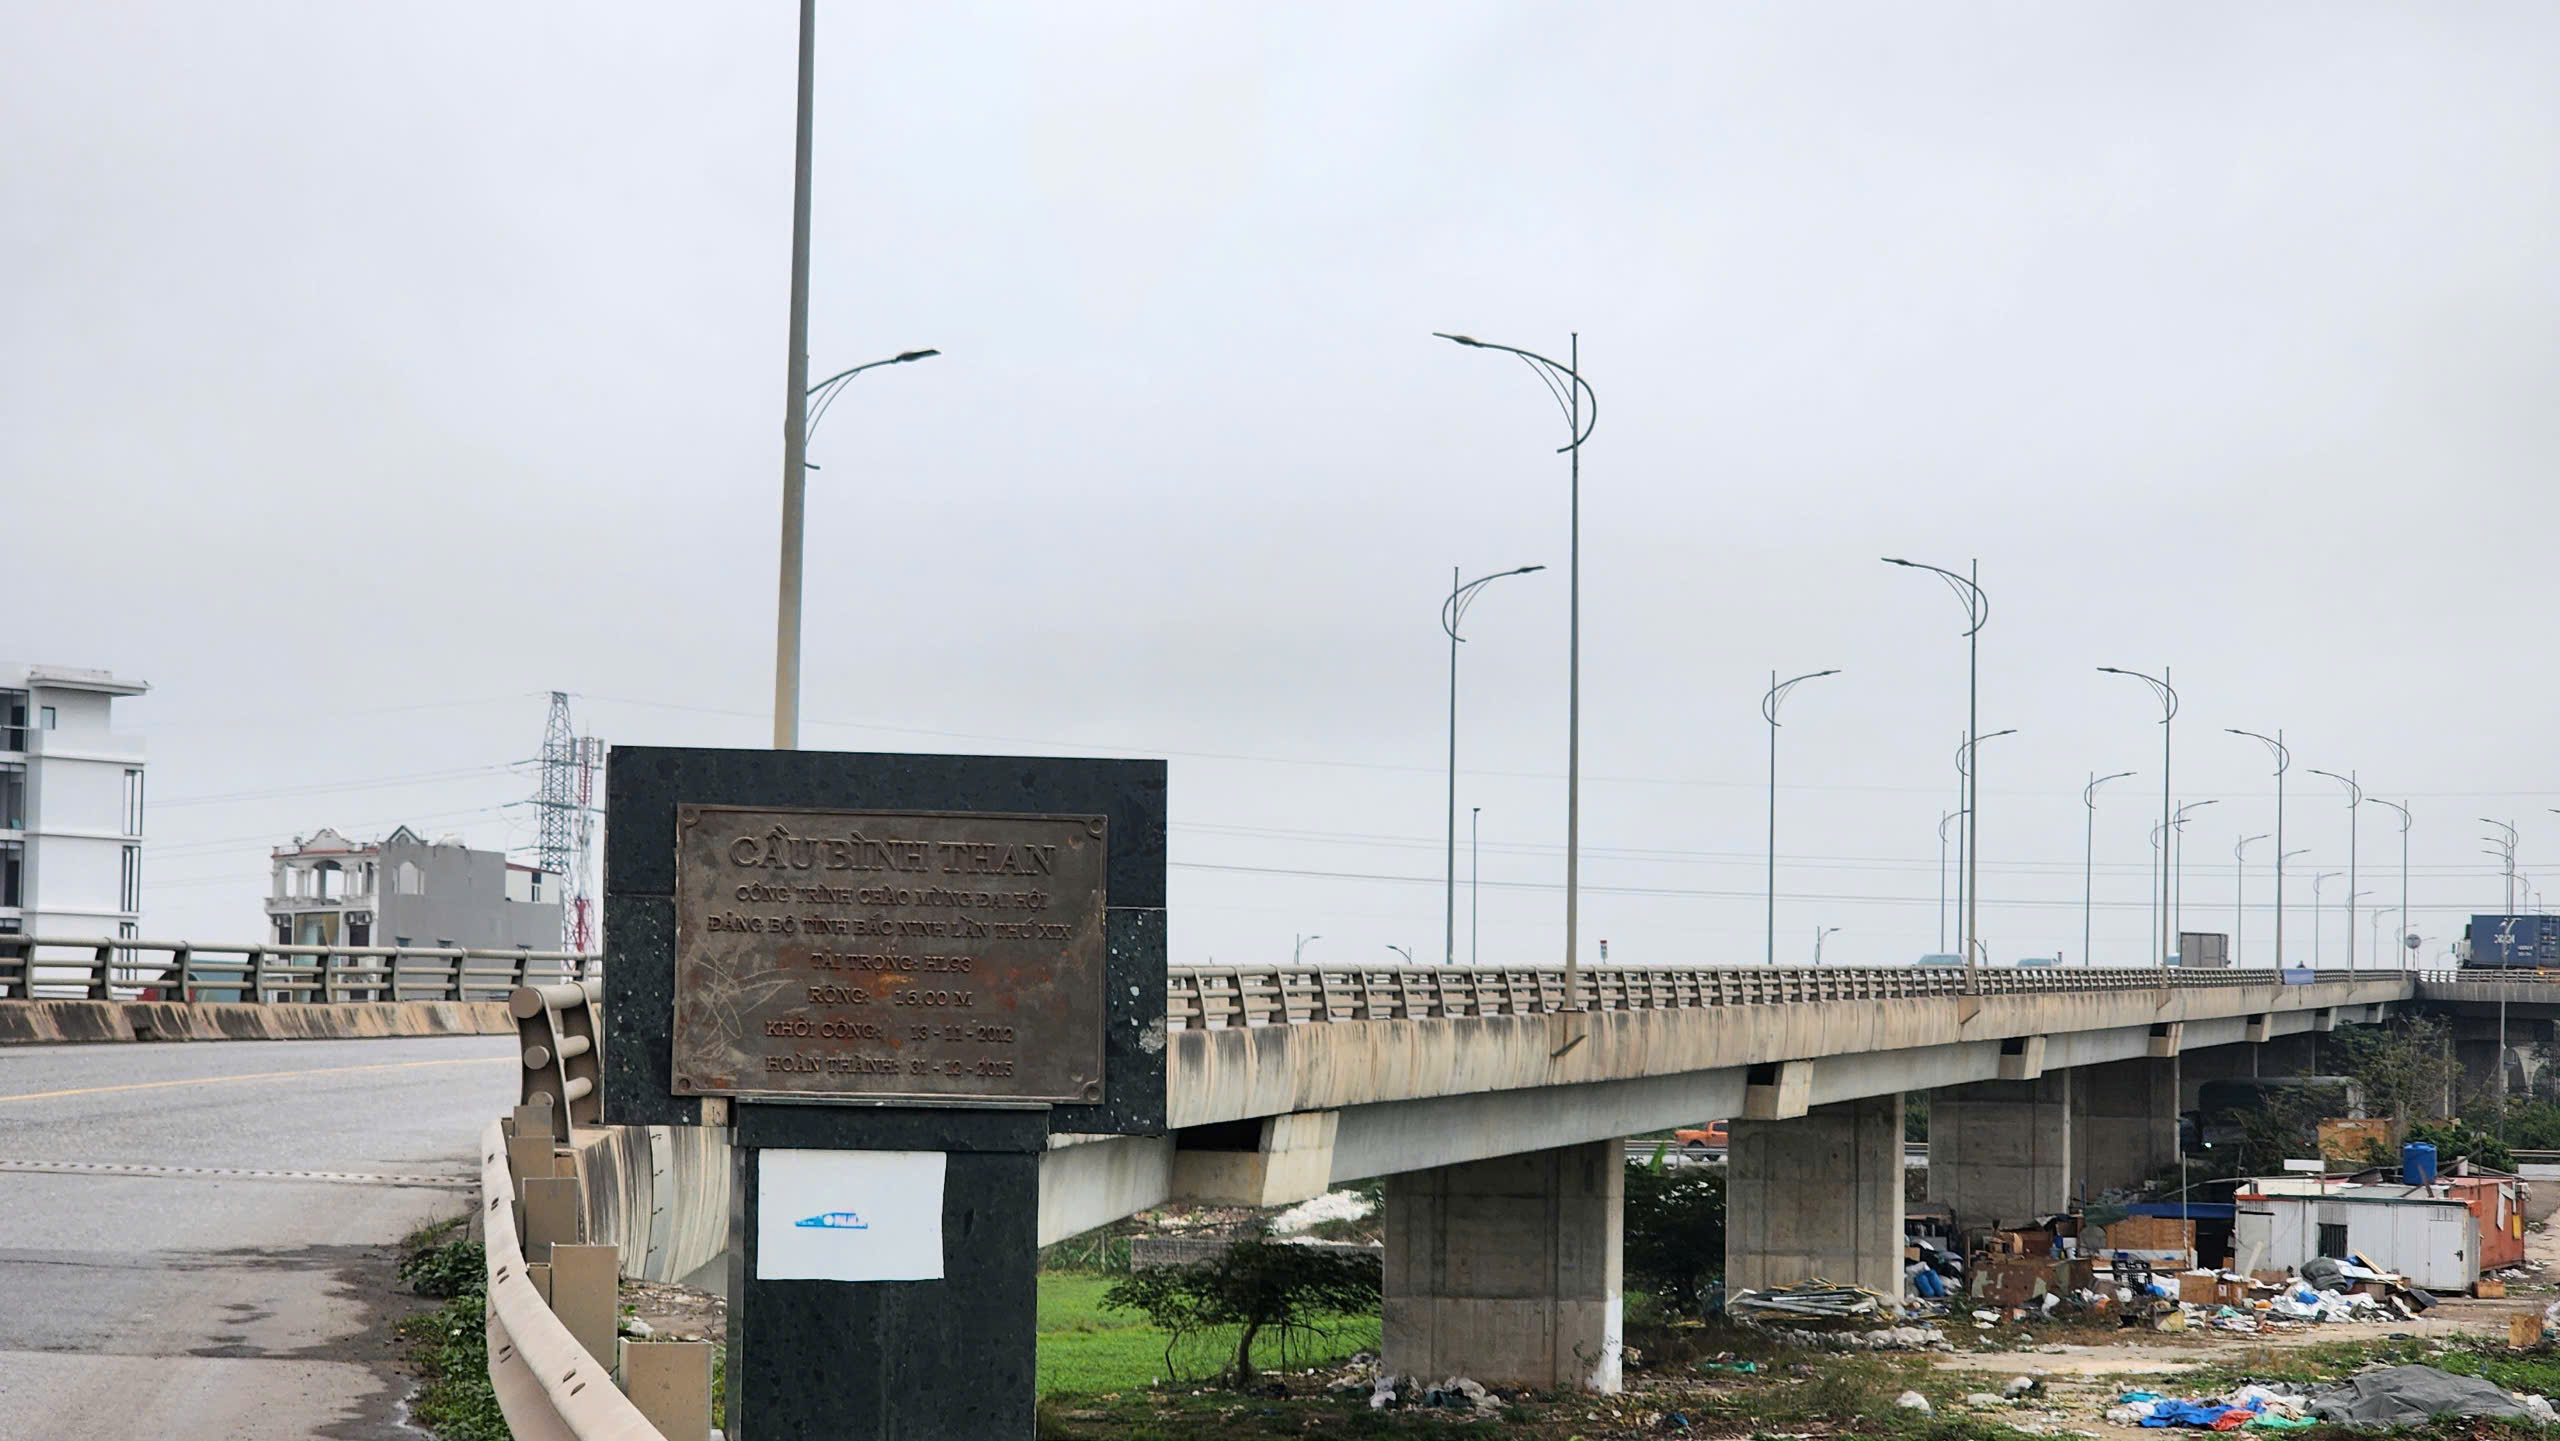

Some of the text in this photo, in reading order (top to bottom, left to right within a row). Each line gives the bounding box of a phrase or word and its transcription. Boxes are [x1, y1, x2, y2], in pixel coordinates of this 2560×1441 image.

[729, 824, 1056, 875] CẦU BÌNH THAN
[736, 881, 791, 902] CÔNG
[795, 882, 852, 905] TRÌNH
[857, 884, 910, 906] CHÀO
[976, 891, 1010, 910] ĐẠI
[1014, 888, 1049, 912] HỘI
[707, 911, 763, 933] ĐẢNG
[768, 914, 796, 937] BỘ
[898, 920, 947, 937] NINH
[951, 915, 989, 938] LẦN
[1038, 923, 1072, 940] XIX
[810, 947, 974, 975] TẢI TRỌNG: HL93
[808, 984, 871, 1008] RỘNG:
[953, 991, 973, 1007] M
[822, 1018, 882, 1039] CÔNG:
[765, 1051, 820, 1073] HOÀN
[826, 1053, 899, 1074] THÀNH:
